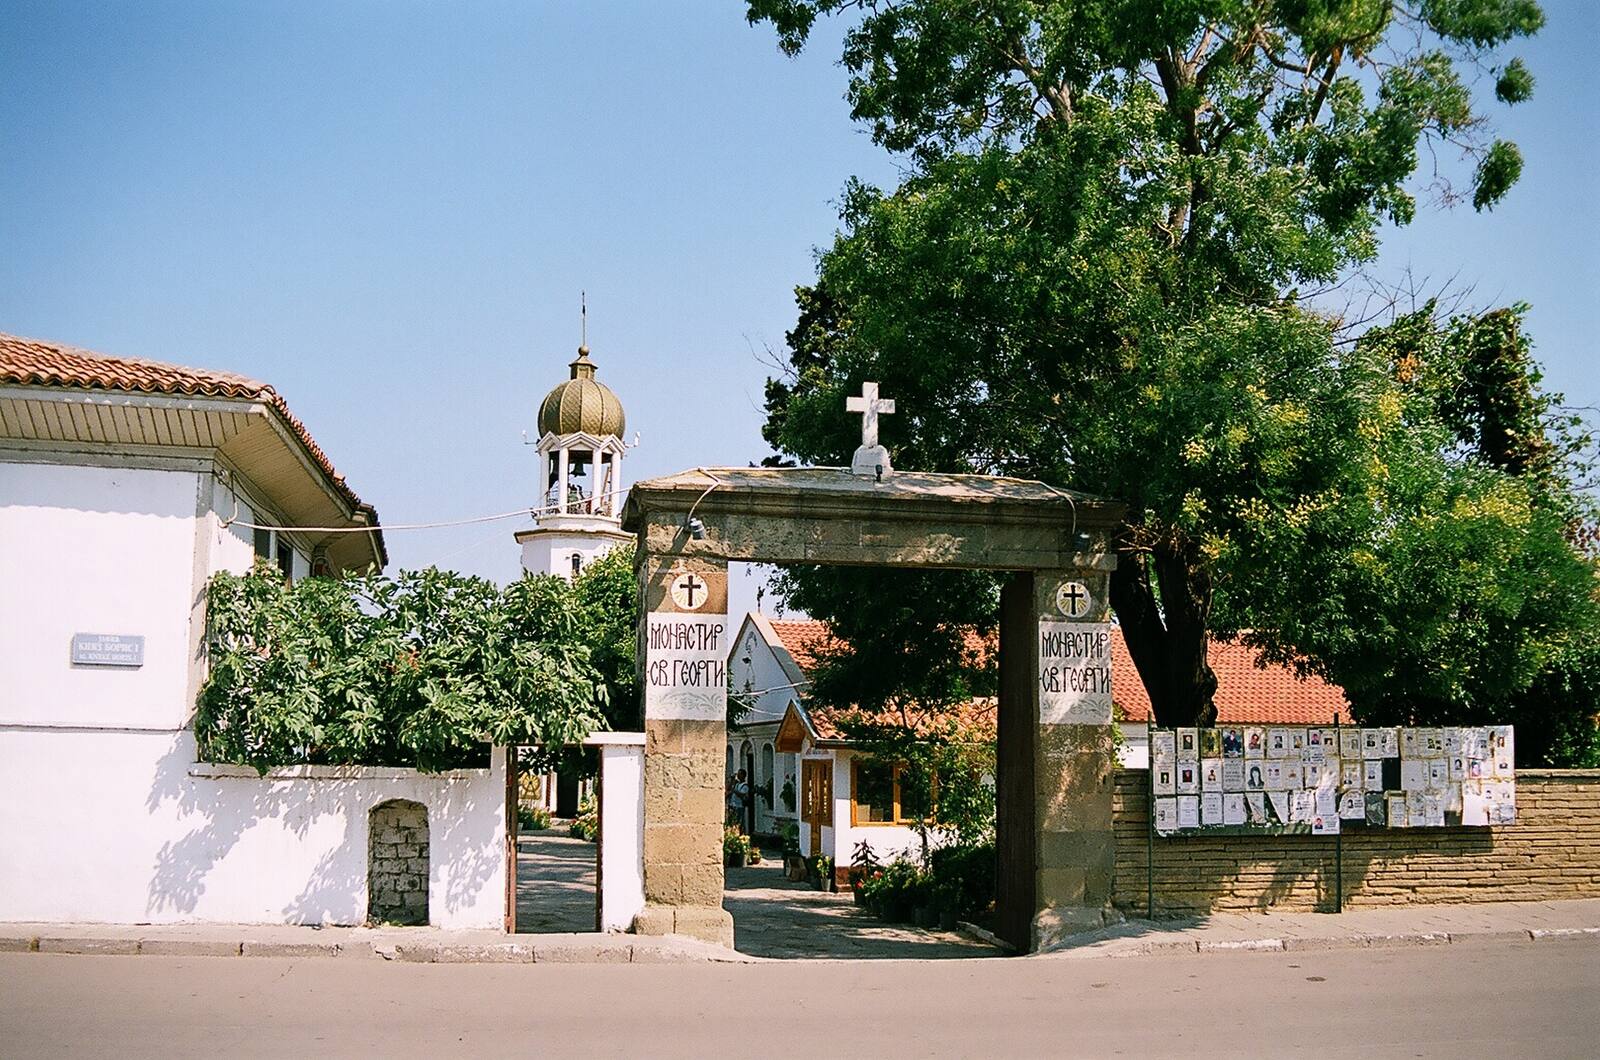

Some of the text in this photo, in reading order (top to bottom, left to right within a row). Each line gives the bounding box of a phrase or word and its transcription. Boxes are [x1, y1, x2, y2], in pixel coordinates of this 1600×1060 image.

[650, 622, 724, 651] МОНАСТИР
[1042, 631, 1108, 658] МОНАСТИР
[673, 660, 724, 687] ГЕОРГИ
[1063, 666, 1110, 693] ГЕОРГИ
